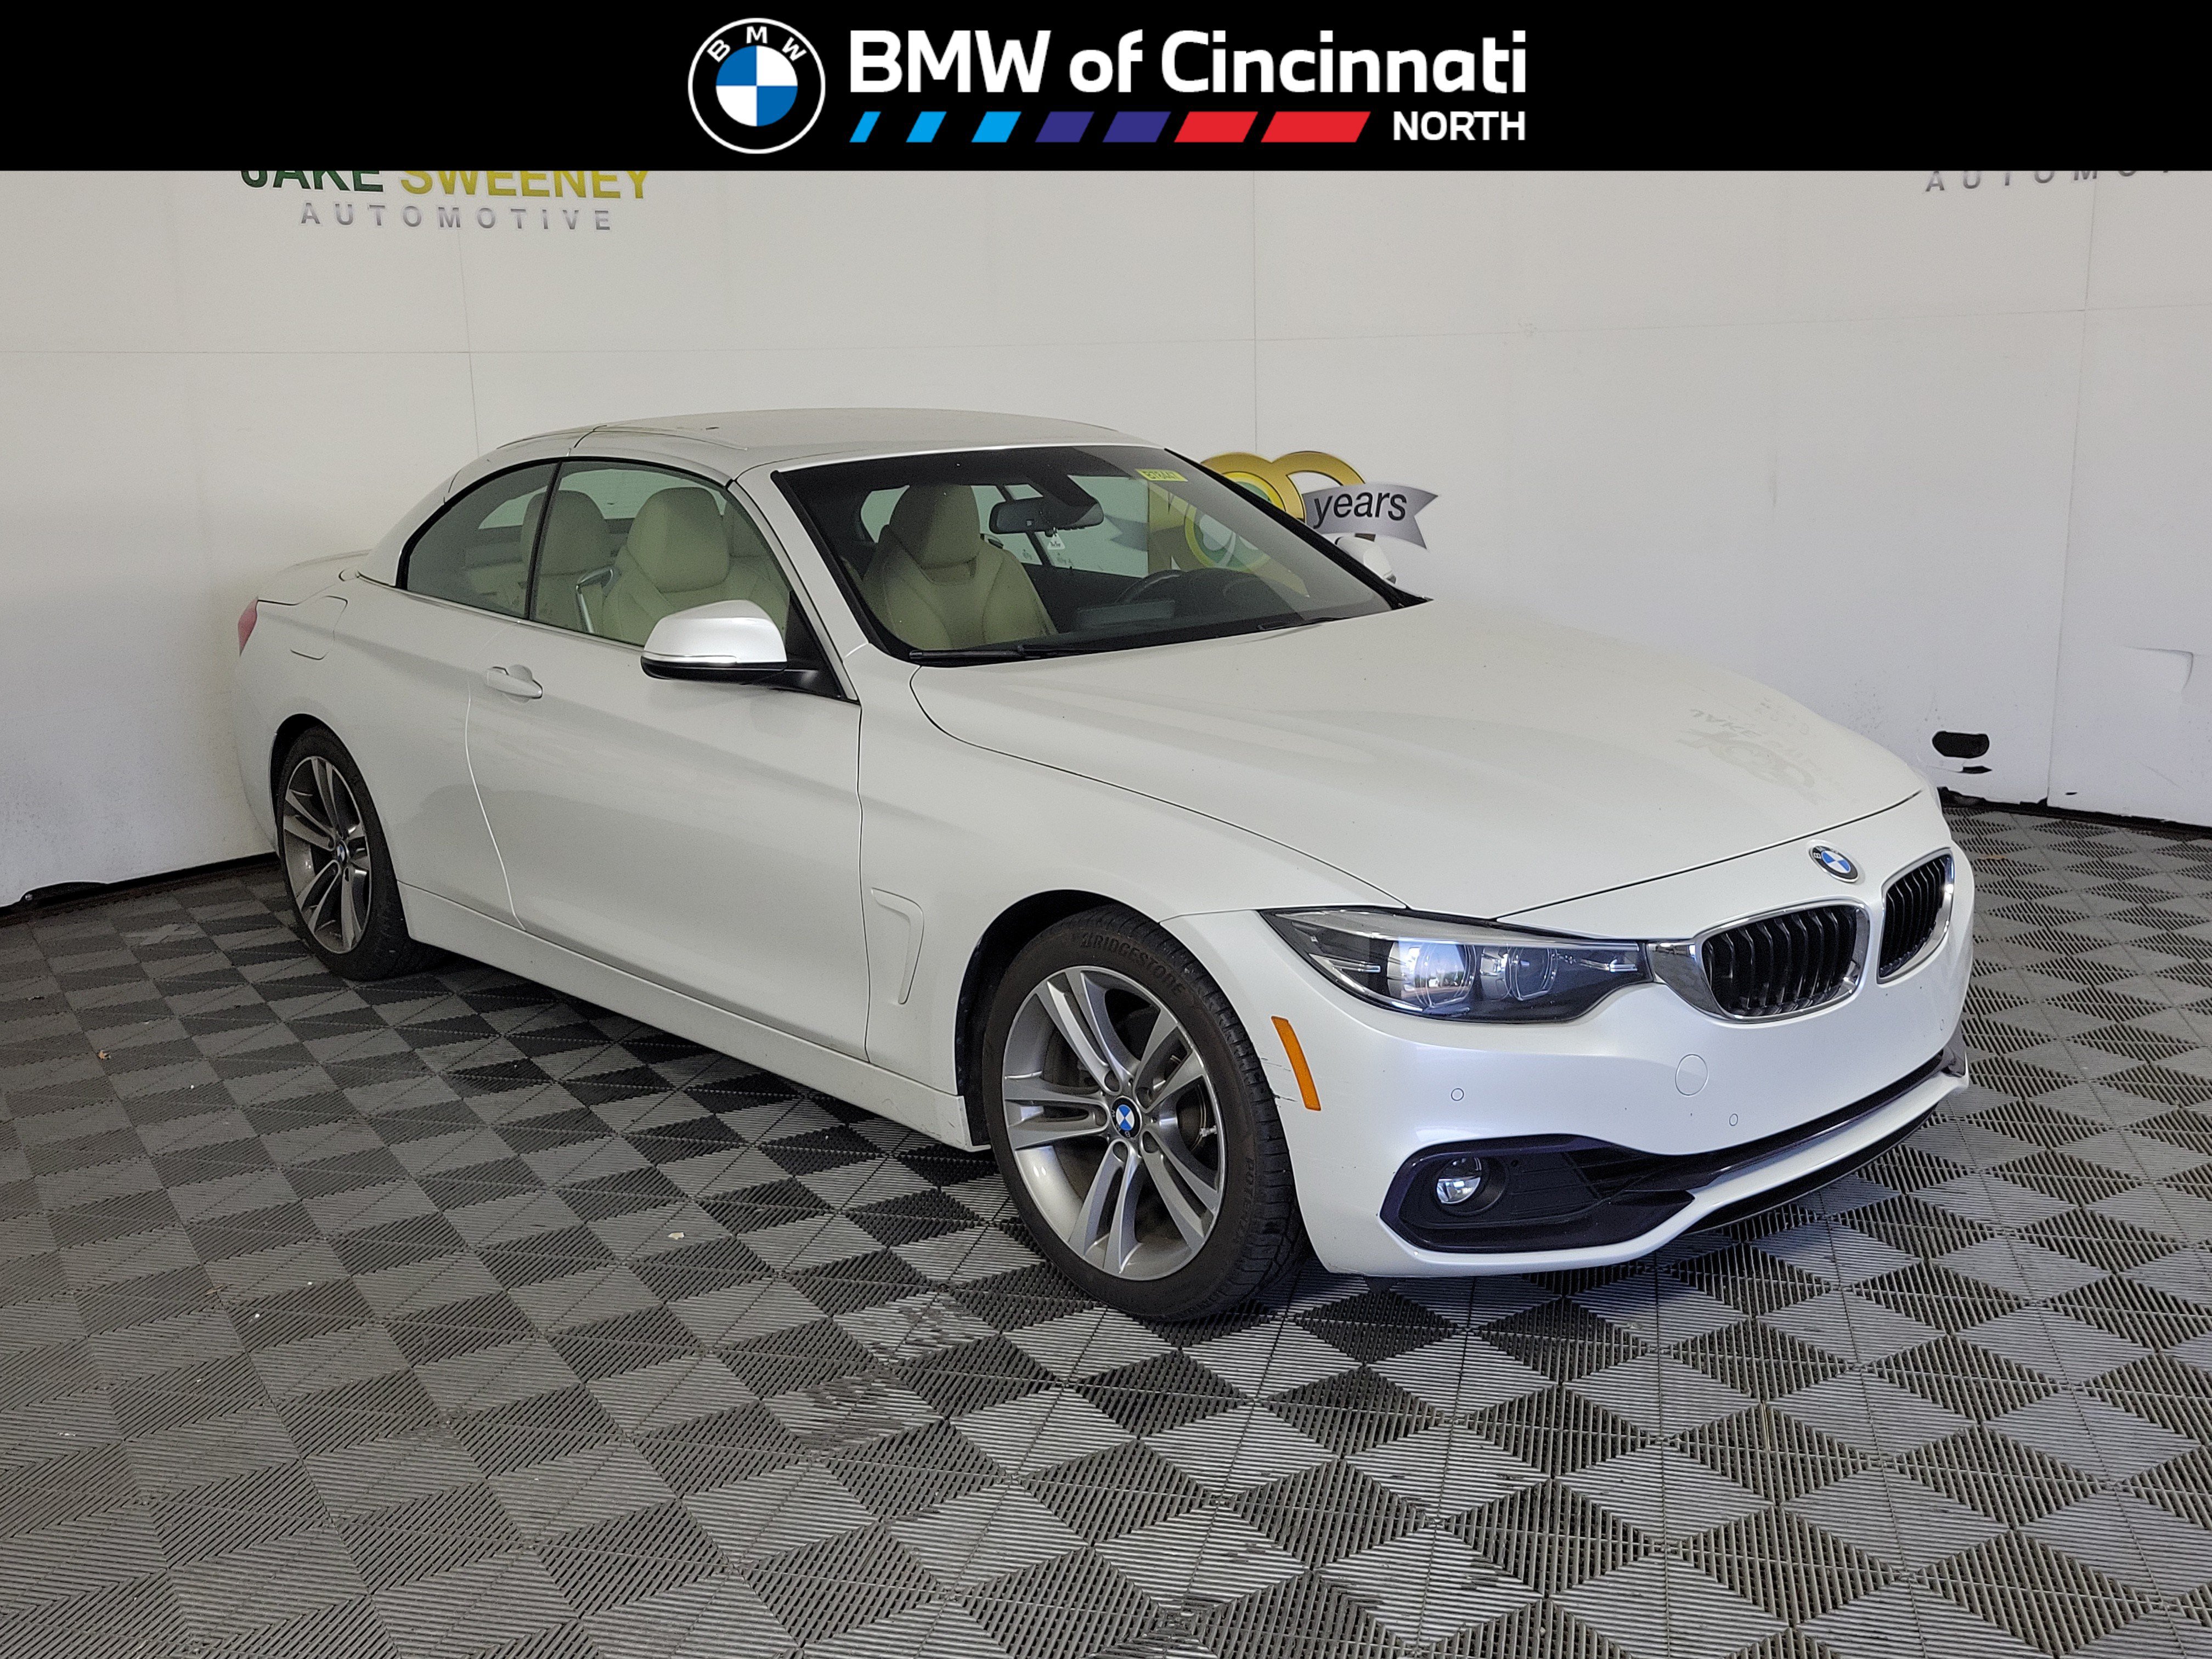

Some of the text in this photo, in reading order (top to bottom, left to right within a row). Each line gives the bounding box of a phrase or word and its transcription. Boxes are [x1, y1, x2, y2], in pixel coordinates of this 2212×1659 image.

[401, 171, 648, 199] SWEENEY
[301, 202, 610, 230] AUTOMOTIVE
[1313, 492, 1407, 529] years
[1080, 933, 1186, 995] BRIDGESTONE
